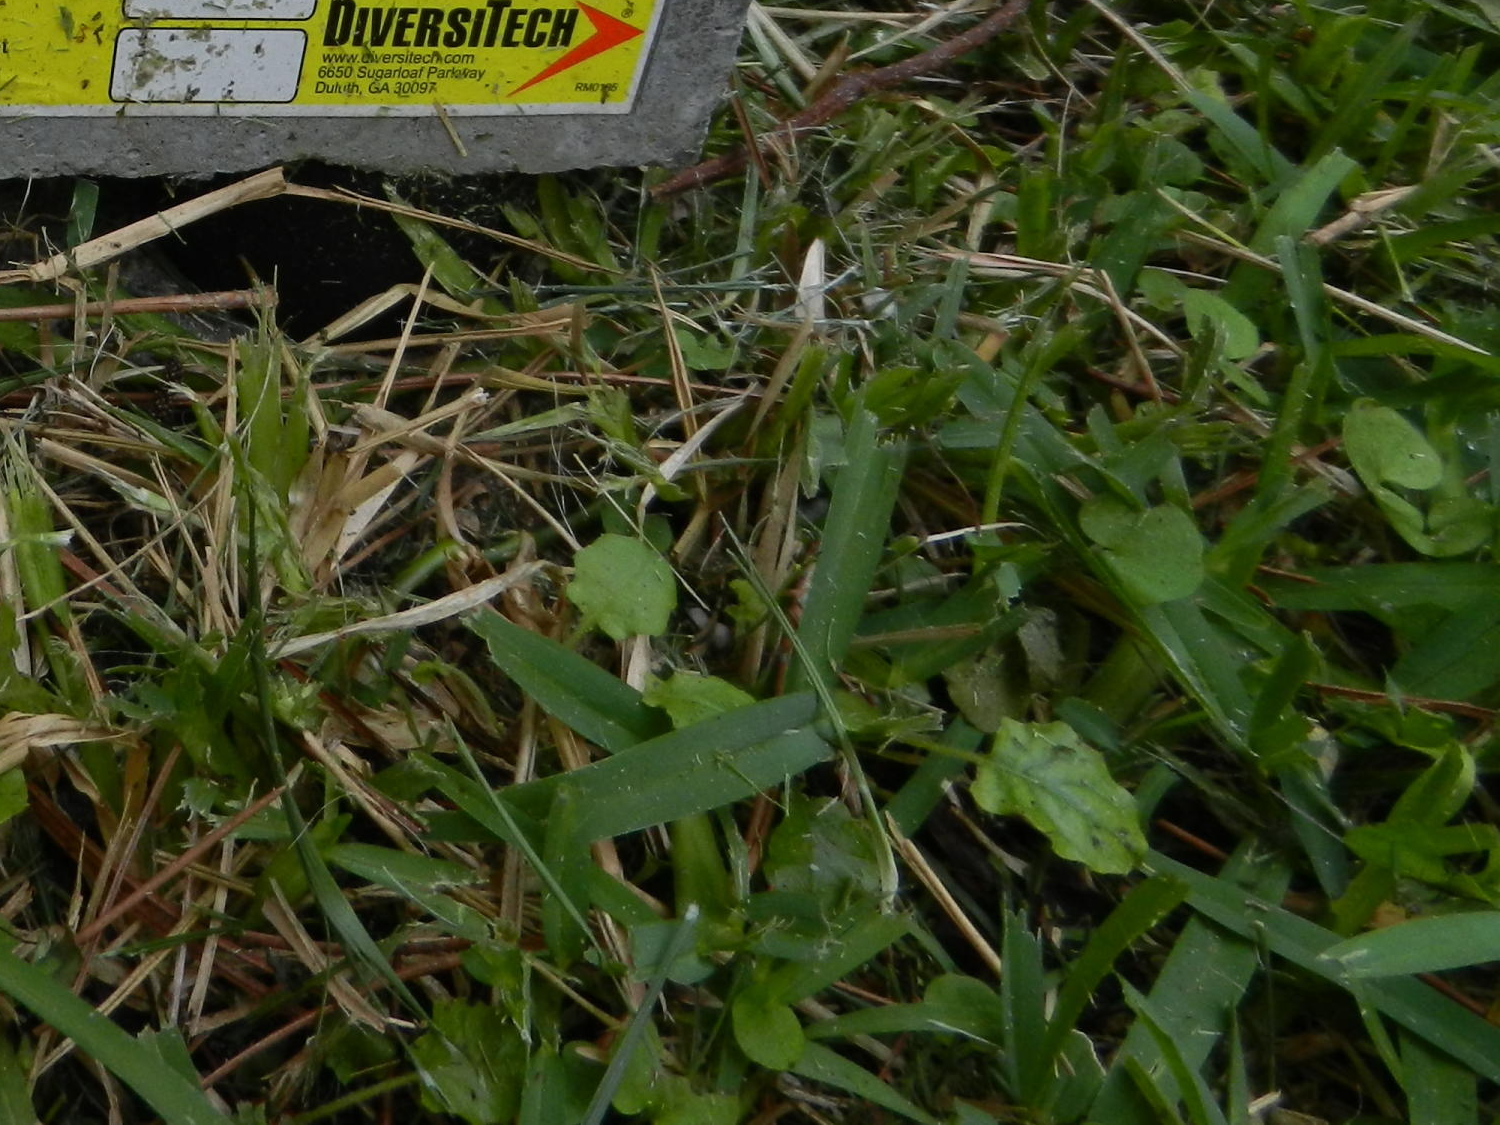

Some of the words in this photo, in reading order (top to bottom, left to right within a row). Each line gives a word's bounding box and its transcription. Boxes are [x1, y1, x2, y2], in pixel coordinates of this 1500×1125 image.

[322, 51, 475, 65] www.dversitechcom
[318, 66, 353, 79] 6650
[356, 66, 424, 82] Sugarloaf
[427, 66, 486, 82] Parkway
[314, 81, 362, 96] Duluth,
[368, 82, 390, 94] GA
[394, 81, 437, 94] 30097
